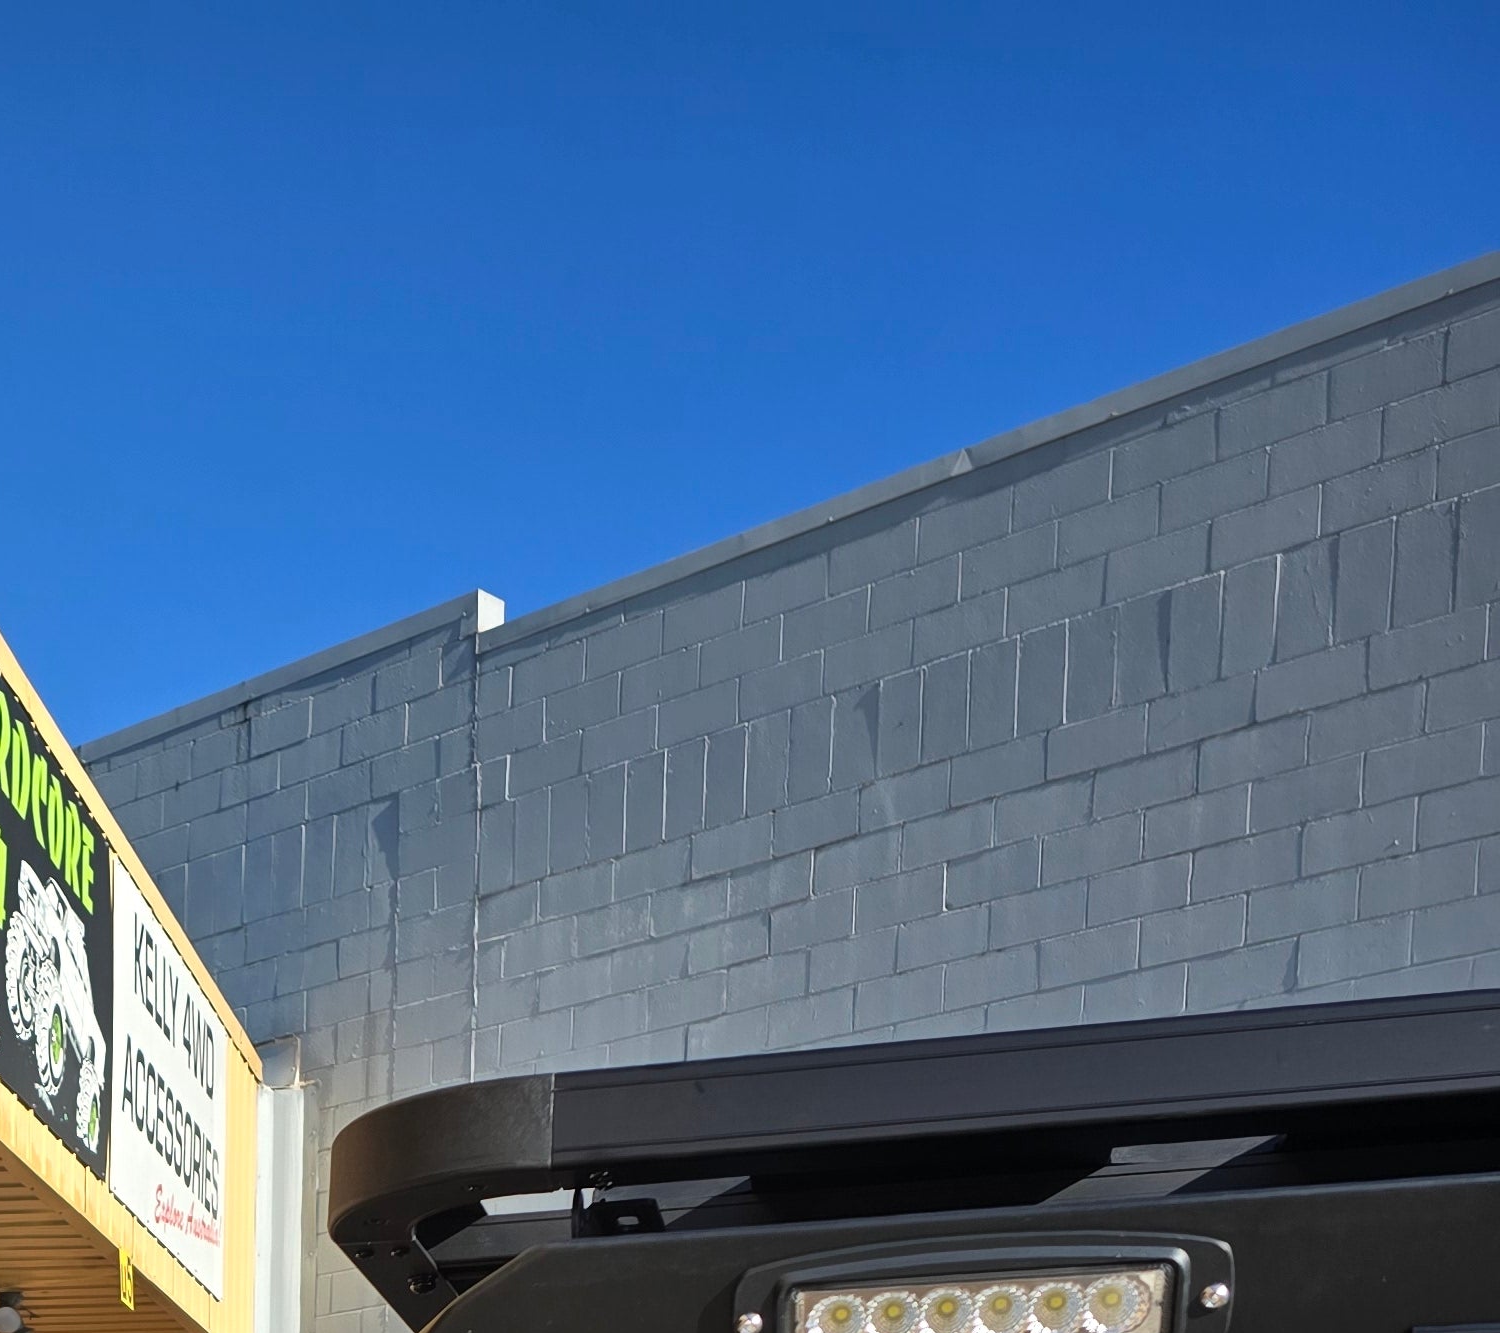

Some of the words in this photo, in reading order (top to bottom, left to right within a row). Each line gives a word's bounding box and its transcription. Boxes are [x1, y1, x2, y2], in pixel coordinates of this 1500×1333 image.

[134, 911, 179, 1048] KELLY
[182, 993, 215, 1101] 4WD
[122, 1033, 219, 1221] ACCESSORIES
